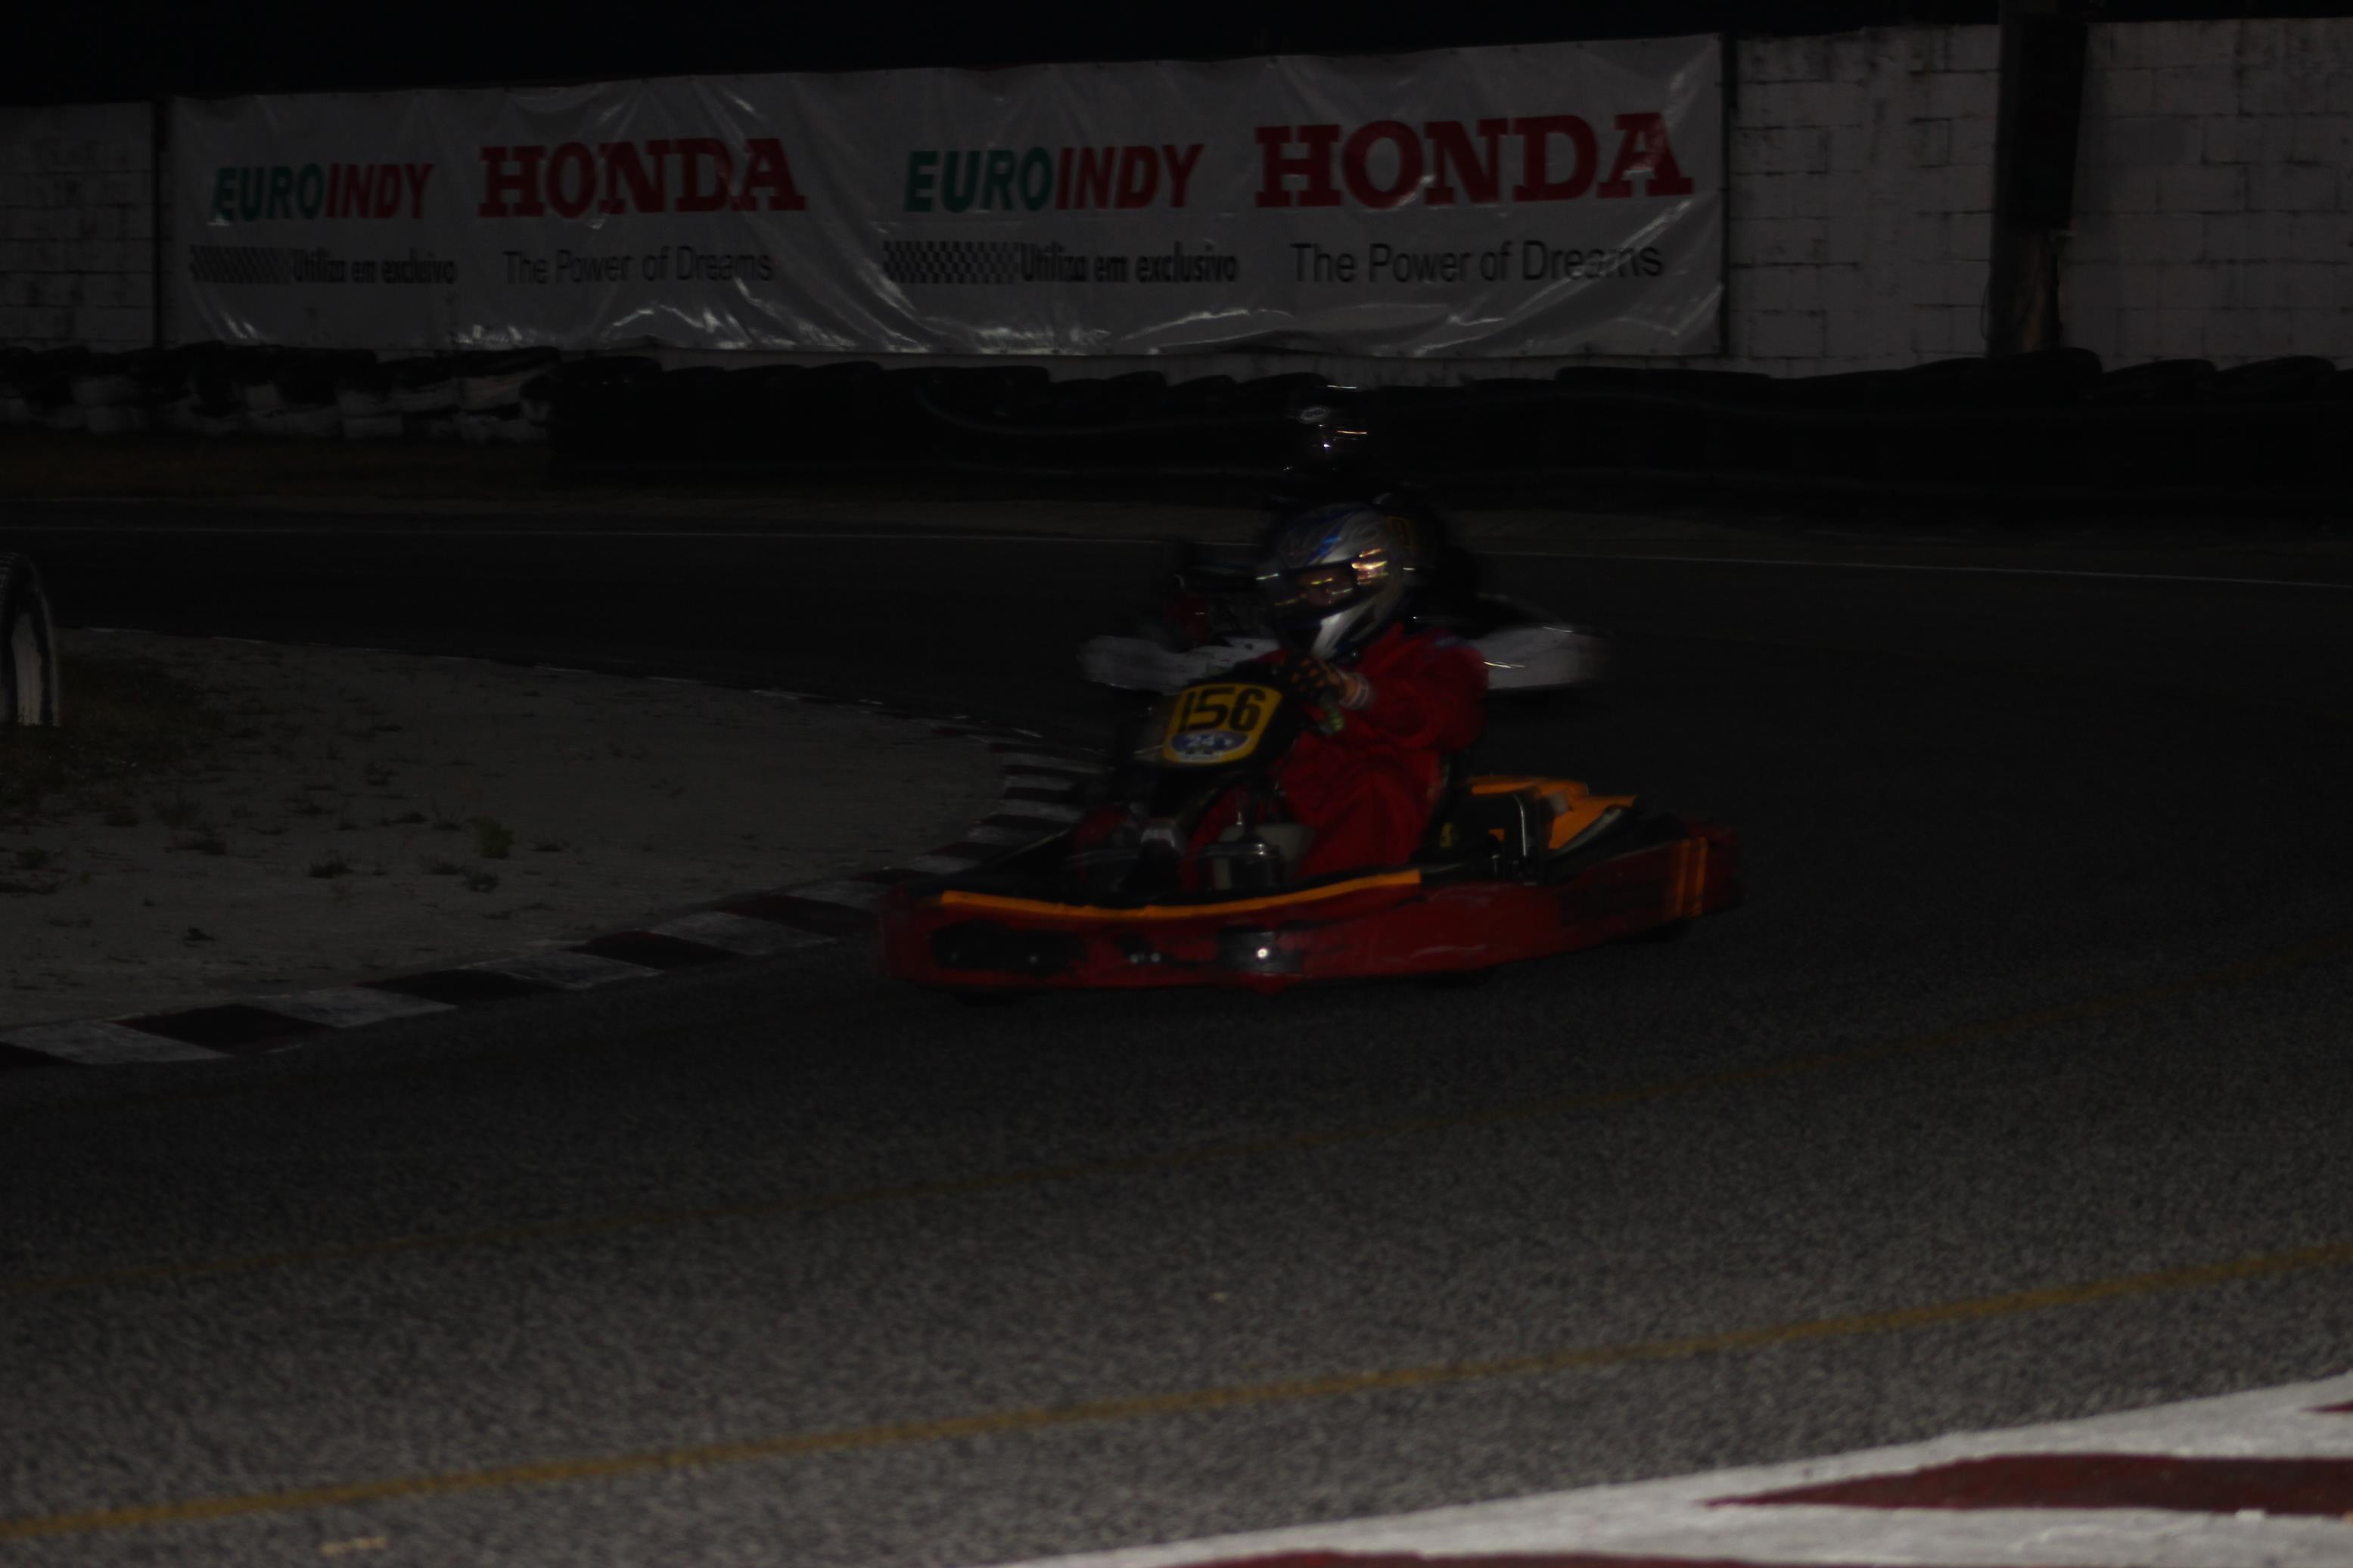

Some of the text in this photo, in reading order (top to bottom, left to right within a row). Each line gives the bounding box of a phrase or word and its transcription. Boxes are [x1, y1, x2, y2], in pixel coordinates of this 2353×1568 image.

[477, 138, 807, 219] HONDA
[904, 144, 1204, 213] EUROINDY
[1256, 112, 1695, 209] HONDA
[351, 259, 376, 284] em
[381, 247, 458, 284] exclusivo
[503, 245, 775, 285] The Power of Dreams
[1021, 241, 1239, 283] Utiliza em exclusivo
[1290, 239, 1663, 283] The Power of Dreams
[1179, 688, 1267, 731] 156
